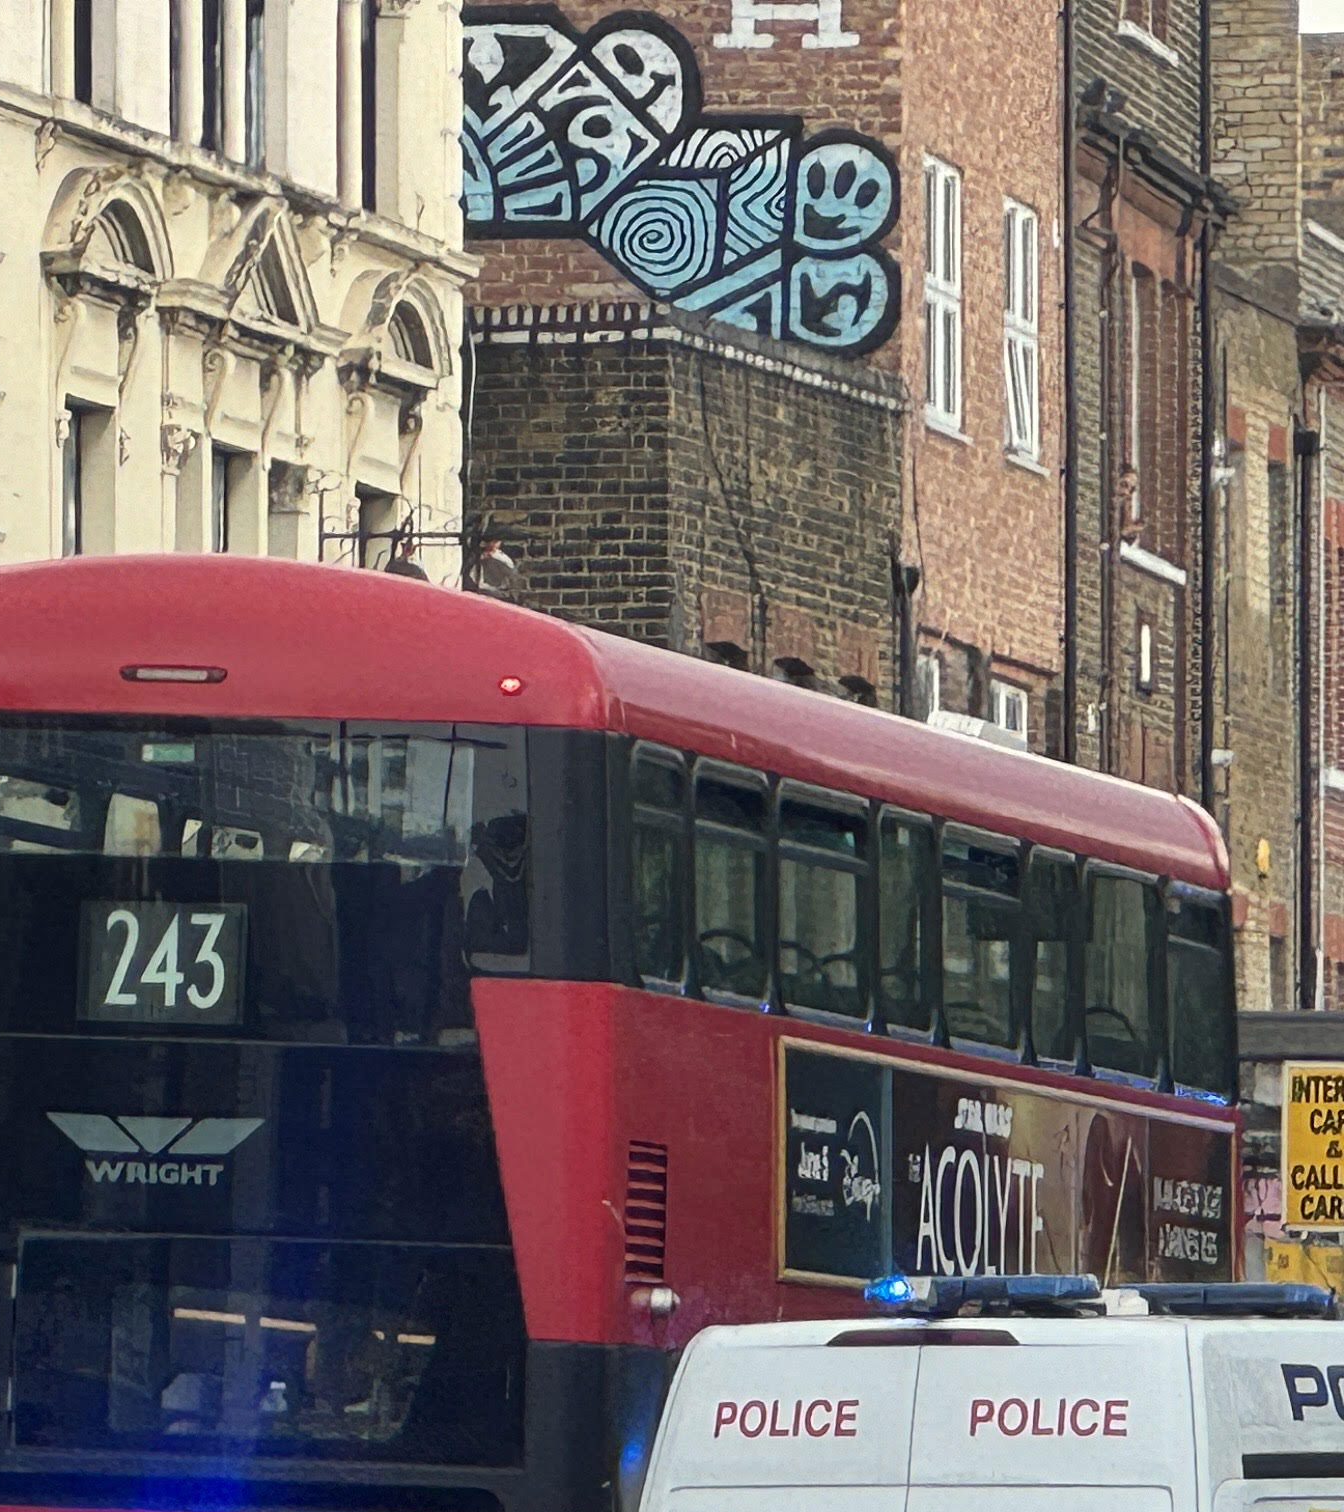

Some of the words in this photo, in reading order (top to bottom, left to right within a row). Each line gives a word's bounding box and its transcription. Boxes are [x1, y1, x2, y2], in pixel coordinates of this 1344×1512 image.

[103, 909, 226, 1010] 243
[1326, 1140, 1343, 1158] &
[84, 1159, 225, 1188] WRIGHT
[915, 1141, 1045, 1276] ACOLYTE
[713, 1400, 860, 1439] POLICE
[968, 1398, 1129, 1438] POLICE
